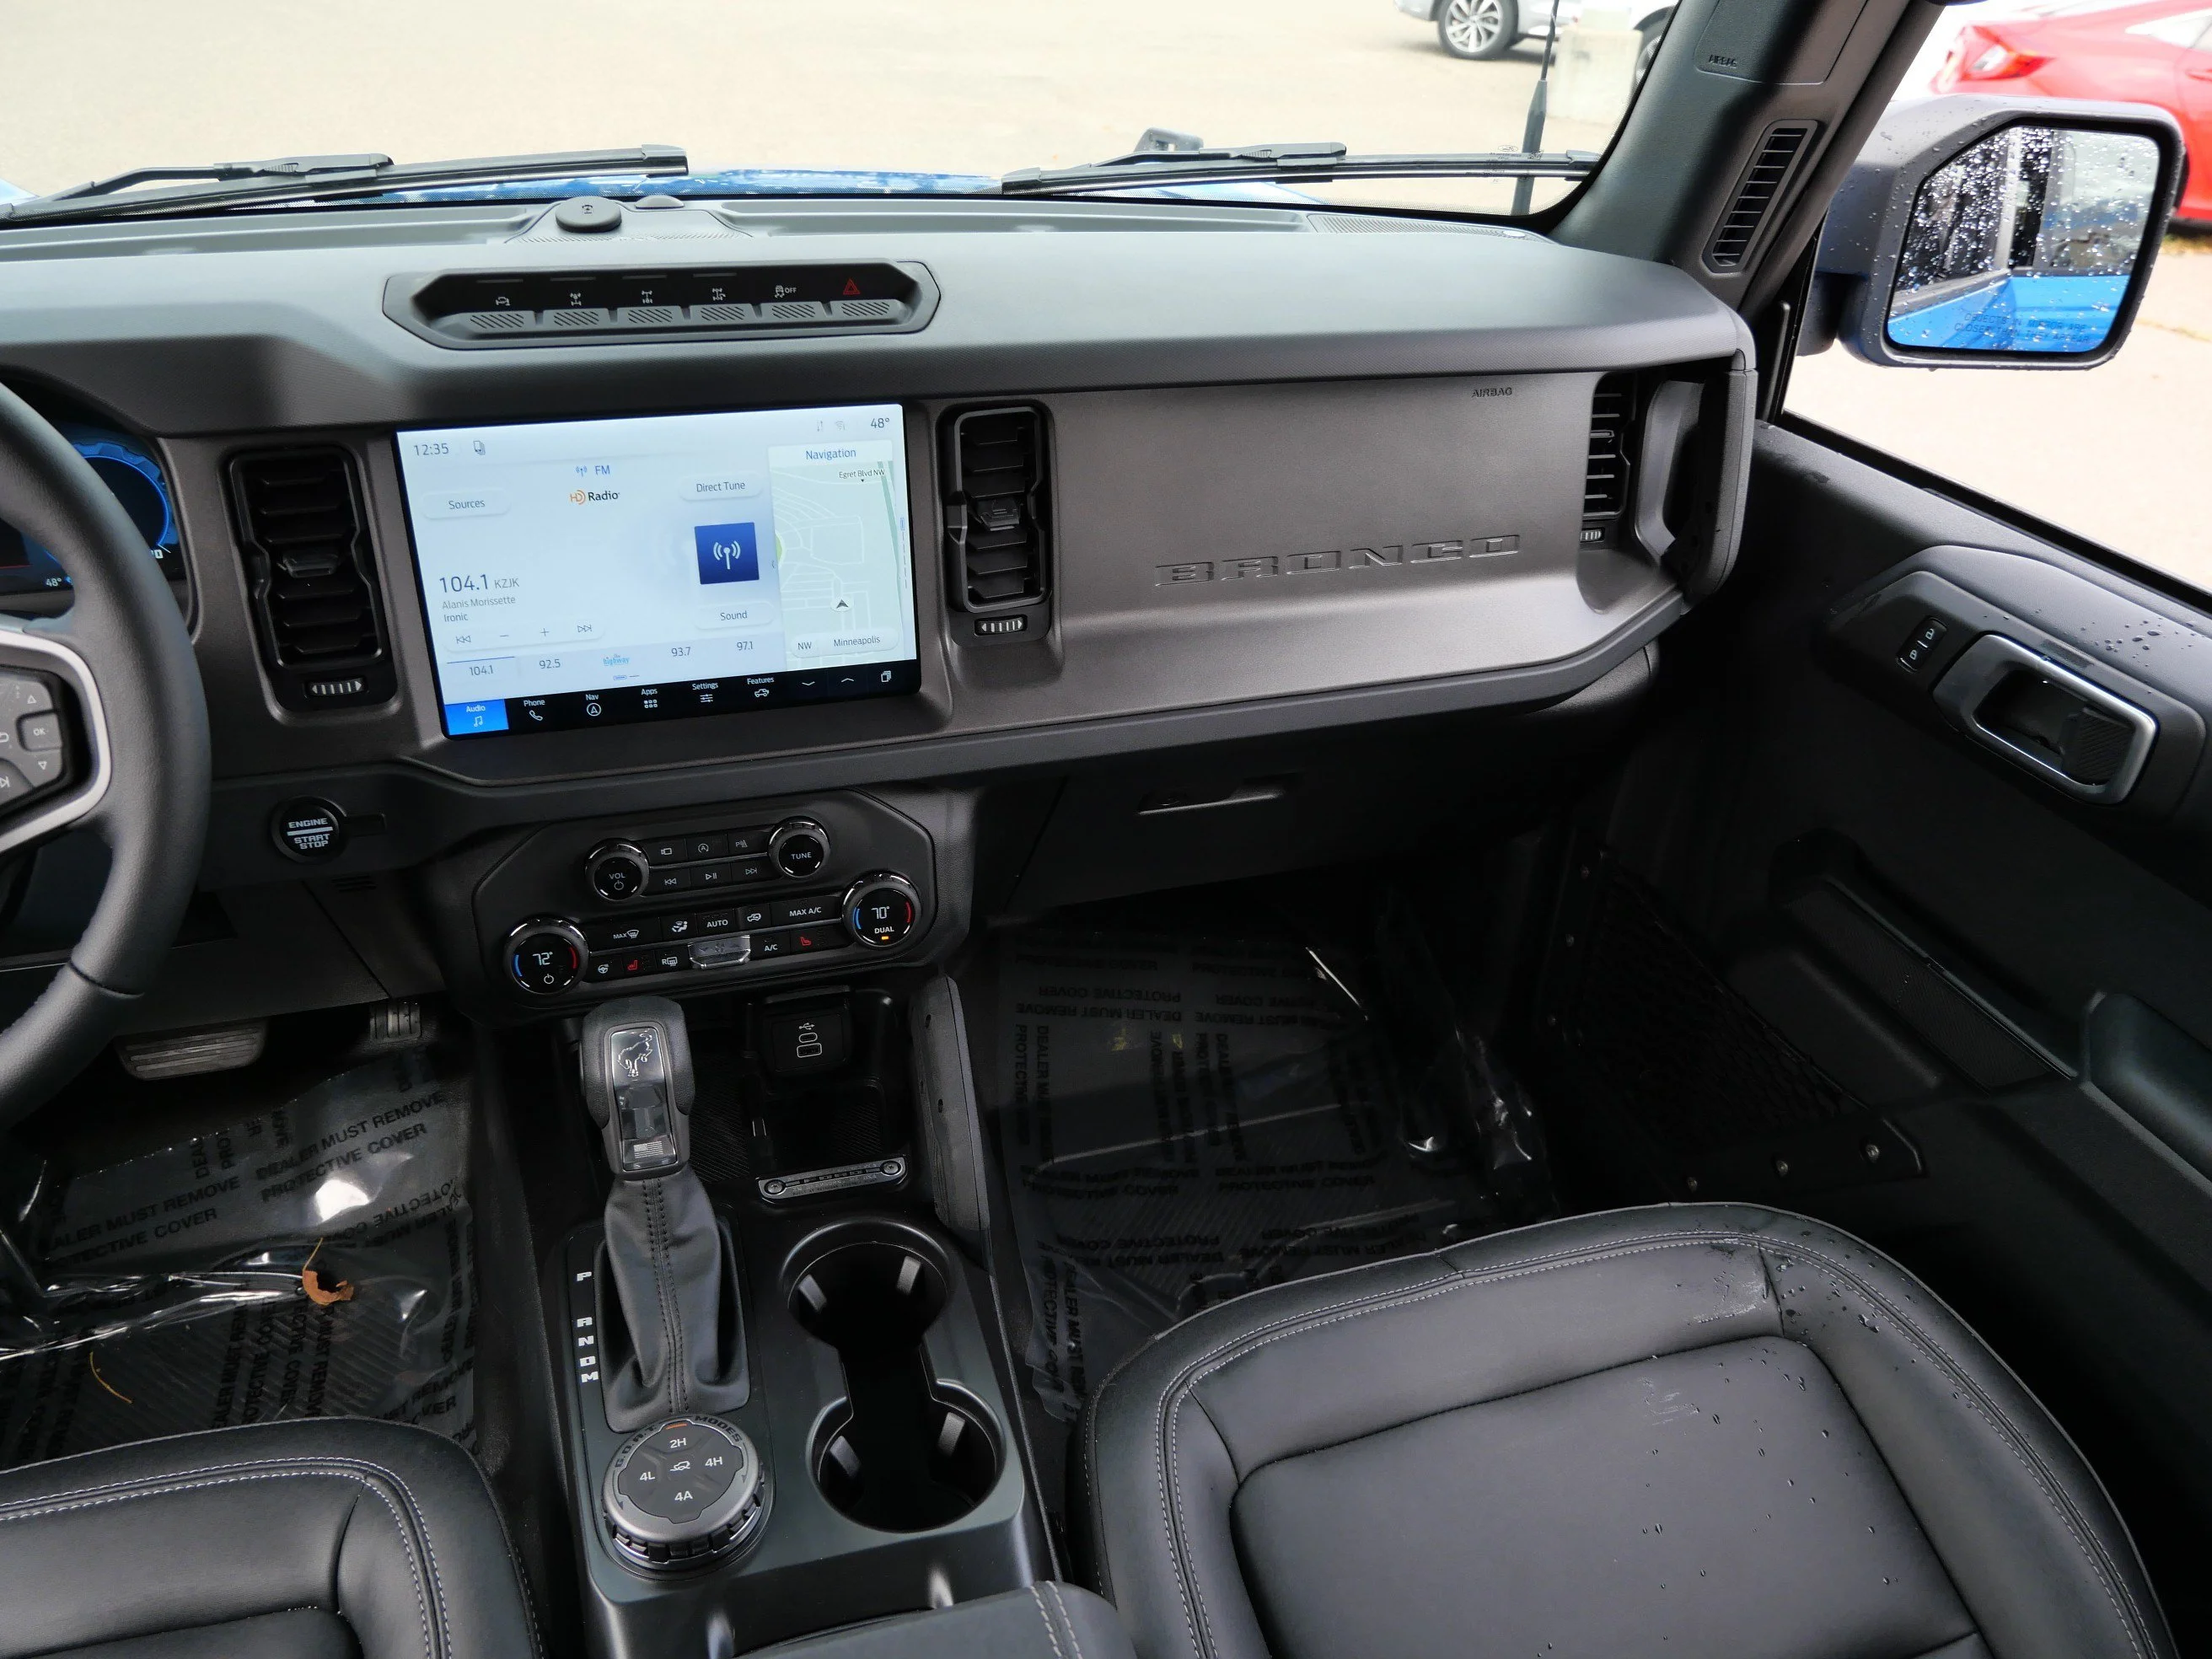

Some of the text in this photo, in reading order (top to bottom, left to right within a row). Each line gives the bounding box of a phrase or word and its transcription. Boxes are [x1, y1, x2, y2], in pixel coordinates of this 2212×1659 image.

[1471, 387, 1513, 399] AIRBAG
[870, 417, 890, 429] 48°
[413, 443, 449, 456] 12:35
[805, 448, 856, 461] Navigation
[594, 465, 610, 475] FM
[839, 468, 885, 480] Egret Blvd NW
[696, 481, 745, 493] Direct Tune
[588, 491, 620, 502] Radio
[448, 498, 486, 511] Sources
[1155, 534, 1520, 587] BRONCO
[439, 573, 520, 593] 104.1 KZJK
[442, 595, 517, 610] Alanis Morissette
[443, 613, 469, 623] Ironic
[720, 609, 748, 621] Sound
[736, 641, 754, 652] 97.1
[797, 636, 881, 651] NW Minneapolis
[671, 647, 691, 658] 93.7
[539, 658, 561, 669] 92.5
[469, 665, 494, 676] 104.1
[691, 681, 719, 691] Settings
[747, 676, 775, 685] Features
[585, 693, 599, 701] Nav
[641, 687, 658, 696] Apps
[523, 698, 545, 707] Phone
[465, 704, 486, 713] Audio
[33, 727, 46, 736] OK
[288, 818, 328, 829] ENGINE
[295, 833, 330, 844] START
[300, 840, 329, 850] STOP
[791, 851, 812, 860] TUNE
[789, 906, 822, 917] MAX A/C
[872, 906, 890, 920] 70°
[706, 919, 728, 928] AUTO
[764, 943, 778, 952] A/C
[533, 952, 553, 966] 72°
[1038, 985, 1181, 1003] PROTECTIVE COVER
[1016, 1002, 1182, 1023] DEALER MUST REMOVE
[1036, 1025, 1050, 1079] DEALER
[255, 1141, 319, 1180] DEALER
[321, 1119, 368, 1152] MUST
[260, 1122, 428, 1202] PROTECTIVE COVER
[373, 1179, 454, 1227] OTECTIVE
[51, 1175, 242, 1250] ALER MUST REMOVE
[153, 1207, 218, 1239] COVER
[1117, 1235, 1220, 1250] PROTECTIVE
[577, 1271, 593, 1281] P
[577, 1317, 593, 1328] R
[578, 1334, 594, 1346] N
[579, 1356, 596, 1367] D
[581, 1371, 599, 1382] M
[695, 1415, 743, 1442] MODES
[669, 1437, 687, 1448] 2H
[705, 1456, 723, 1467] 4H
[639, 1472, 655, 1481] 4L
[674, 1490, 693, 1501] 4A
